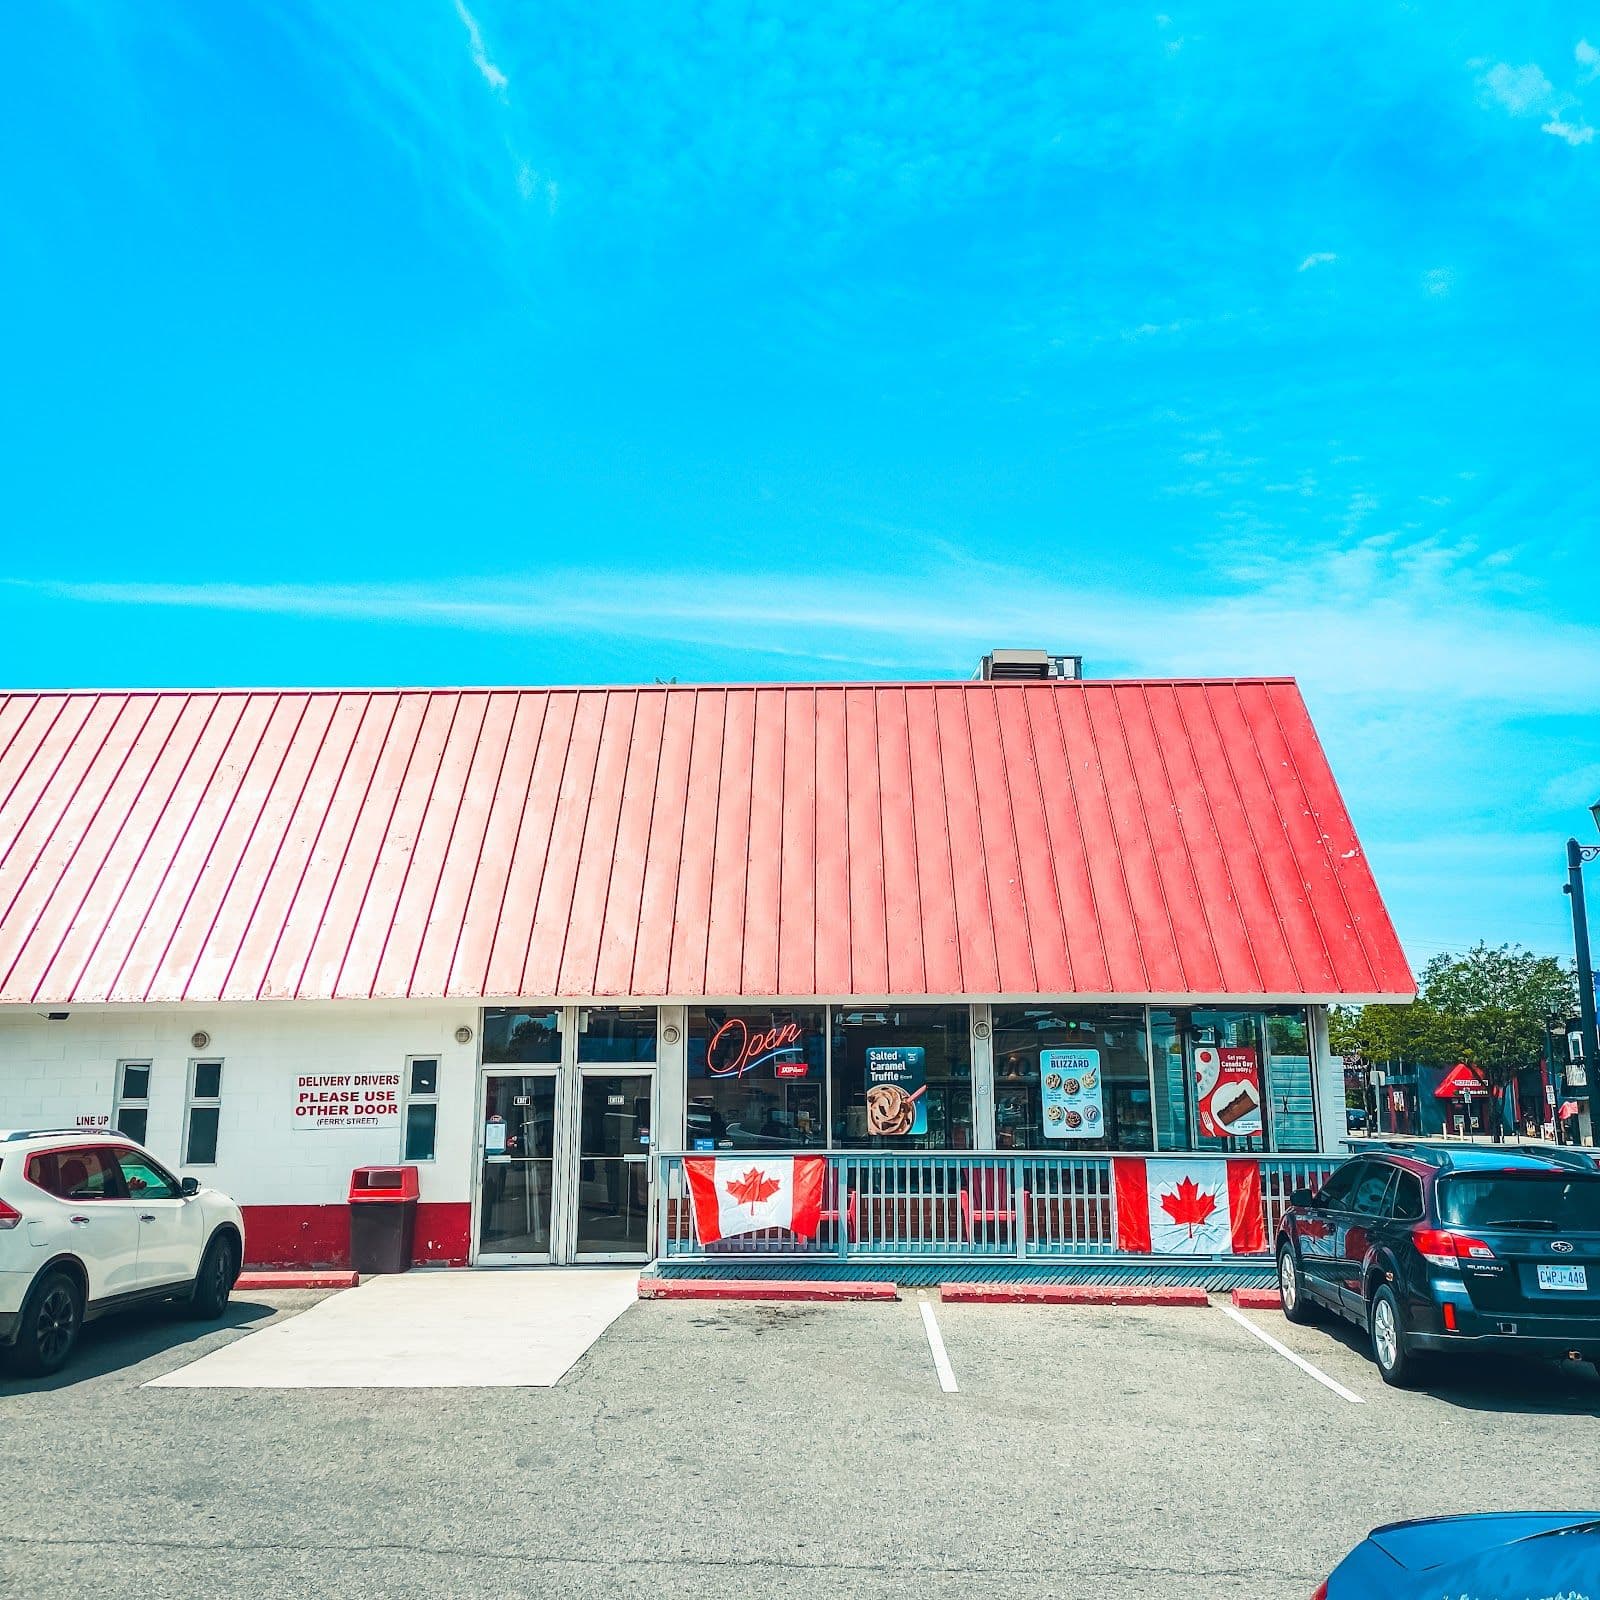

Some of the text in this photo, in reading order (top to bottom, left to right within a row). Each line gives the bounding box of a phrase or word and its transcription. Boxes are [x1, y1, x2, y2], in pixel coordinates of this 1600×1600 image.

[707, 1018, 802, 1078] Open
[870, 1051, 898, 1060] Salted
[870, 1061, 906, 1071] Caramel
[1050, 1060, 1090, 1068] BLIZZARD
[298, 1075, 400, 1087] DELIVERY DRIVERS
[870, 1071, 899, 1081] Truffle
[299, 1091, 396, 1103] PLEASE USE
[295, 1104, 398, 1116] OTHER DOOR
[76, 1116, 109, 1126] LINE UP
[317, 1117, 379, 1127] (FERRY STREET)
[1466, 1264, 1504, 1272] SUBARU
